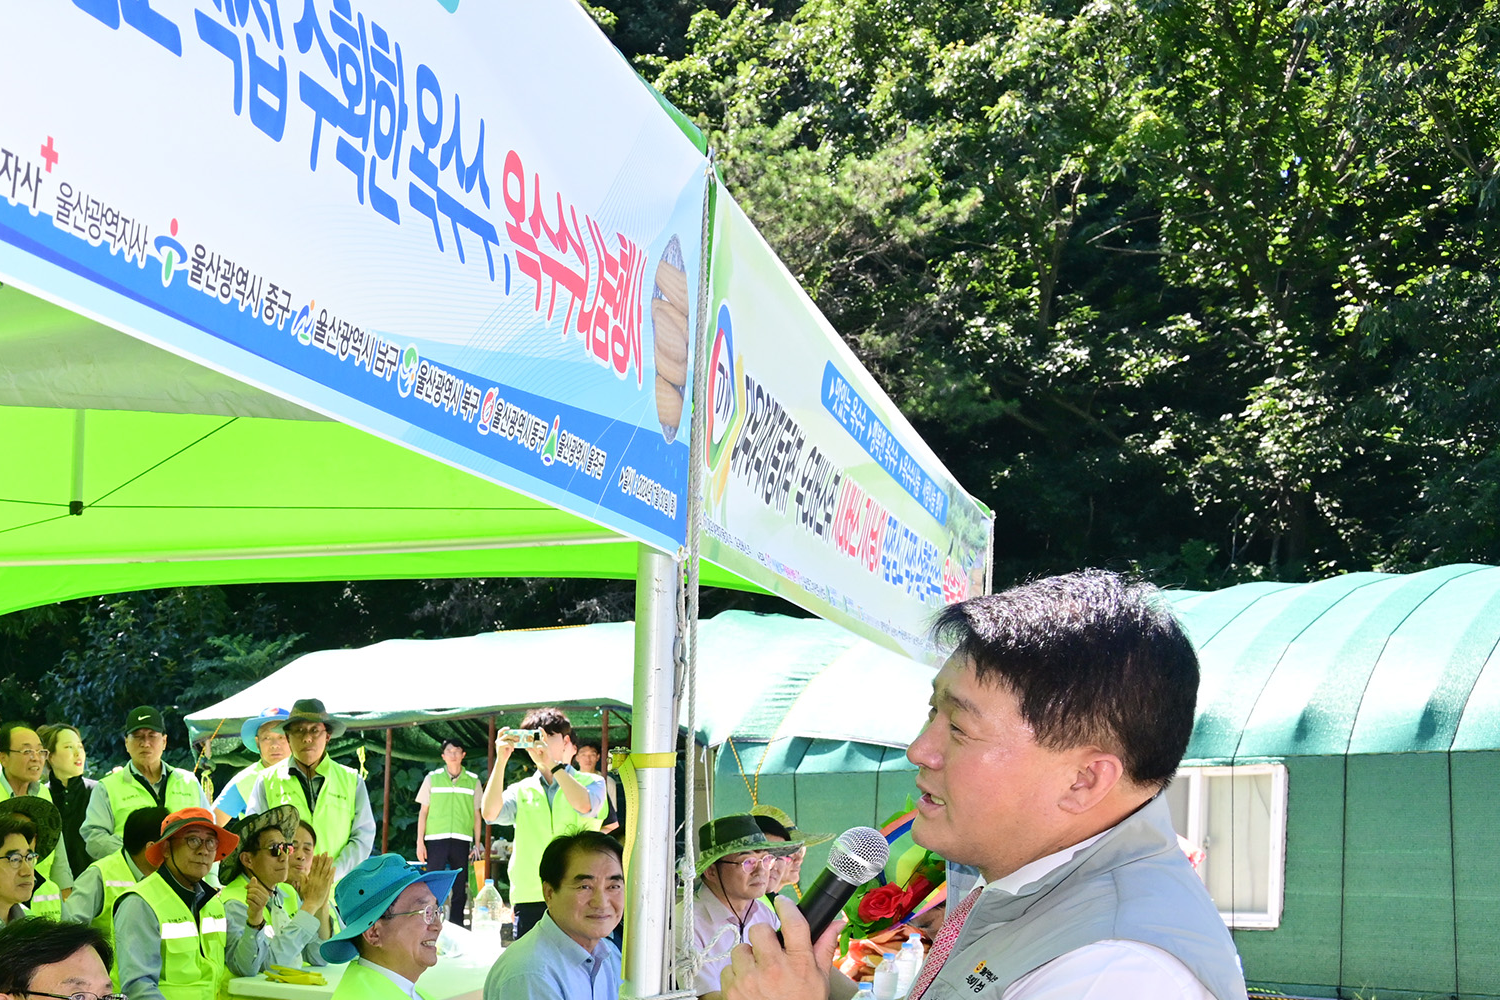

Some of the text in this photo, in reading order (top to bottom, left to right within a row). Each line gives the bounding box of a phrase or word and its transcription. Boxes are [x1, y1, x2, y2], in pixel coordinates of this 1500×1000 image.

[55, 181, 149, 263] 울산광역지사
[190, 243, 292, 326] 울산광역시 중구
[313, 308, 399, 381] 울산광역시 남구
[416, 359, 480, 422] 울산광역시 북구
[557, 431, 591, 474] 울산광역시
